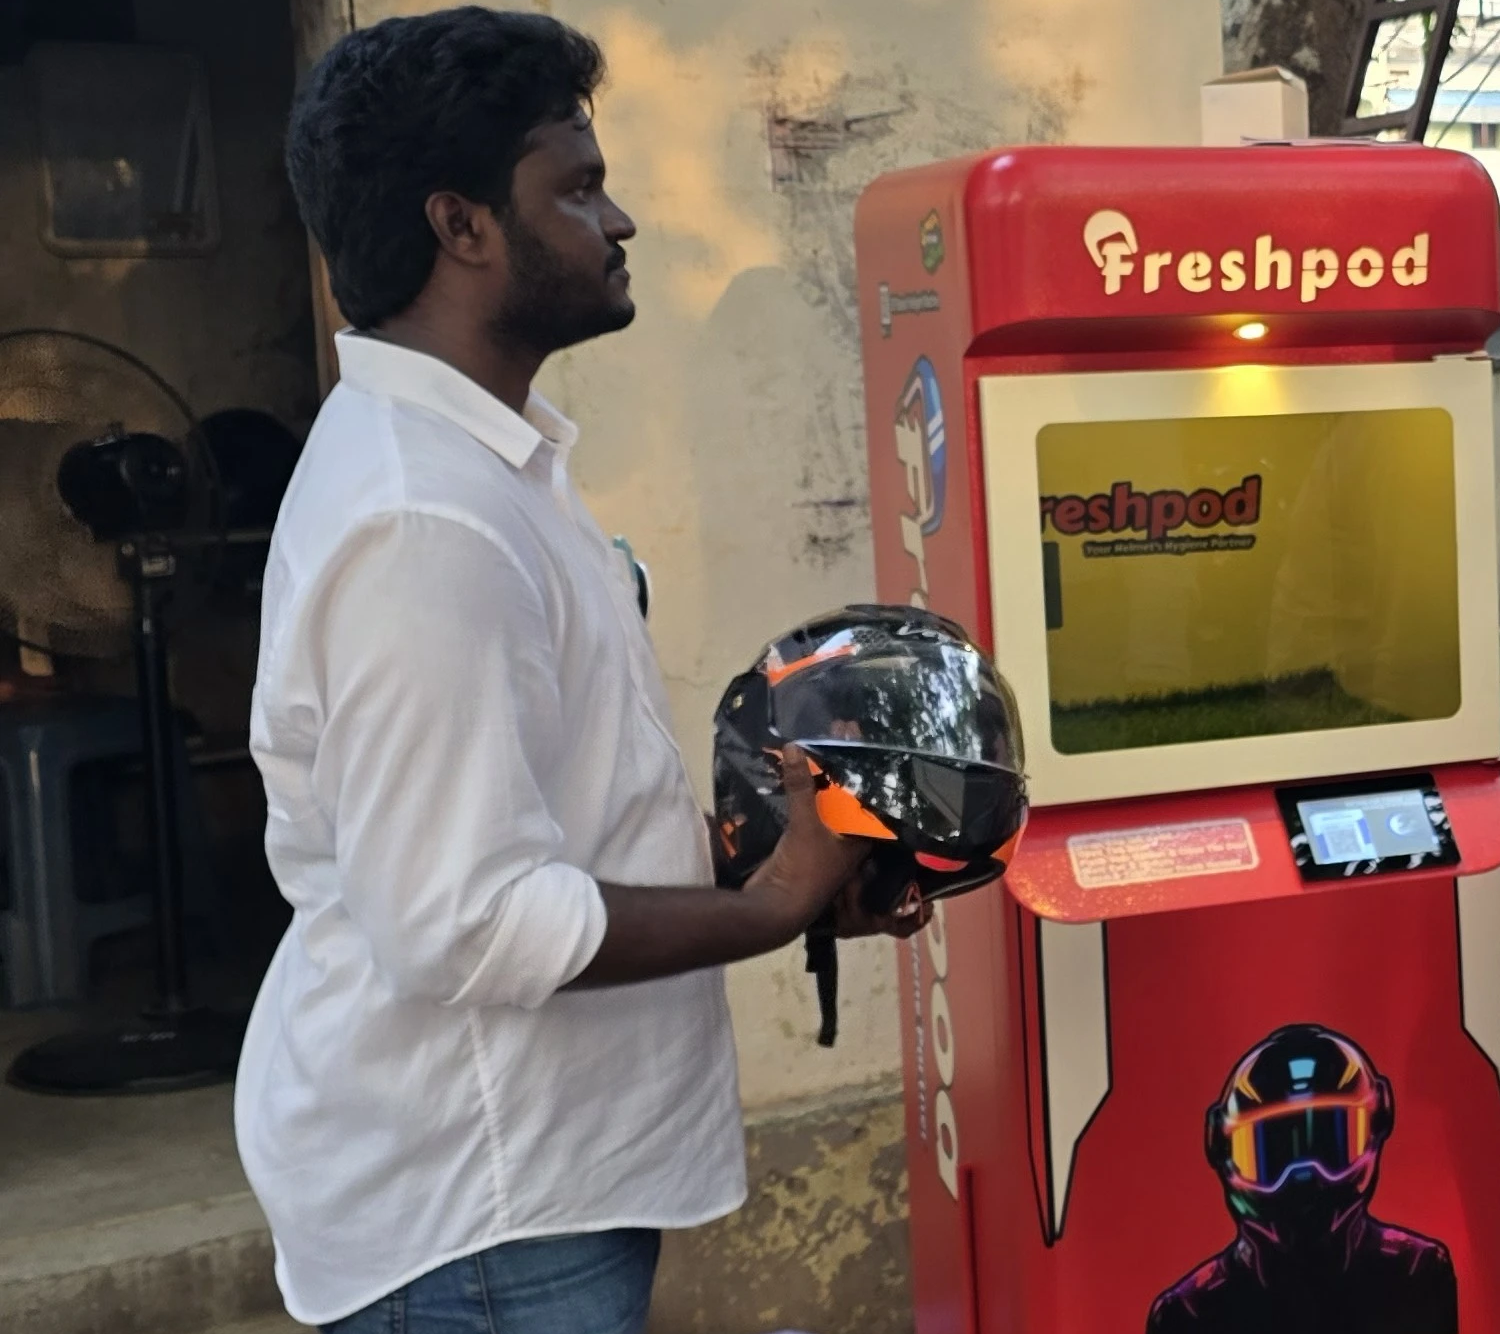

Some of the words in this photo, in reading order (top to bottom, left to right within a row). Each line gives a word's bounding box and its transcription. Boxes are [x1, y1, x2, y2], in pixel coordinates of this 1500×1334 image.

[1100, 231, 1430, 303] Freshpod
[1041, 476, 1261, 539] reshpod
[1165, 539, 1210, 552] Hygiene
[1211, 537, 1253, 548] Partner
